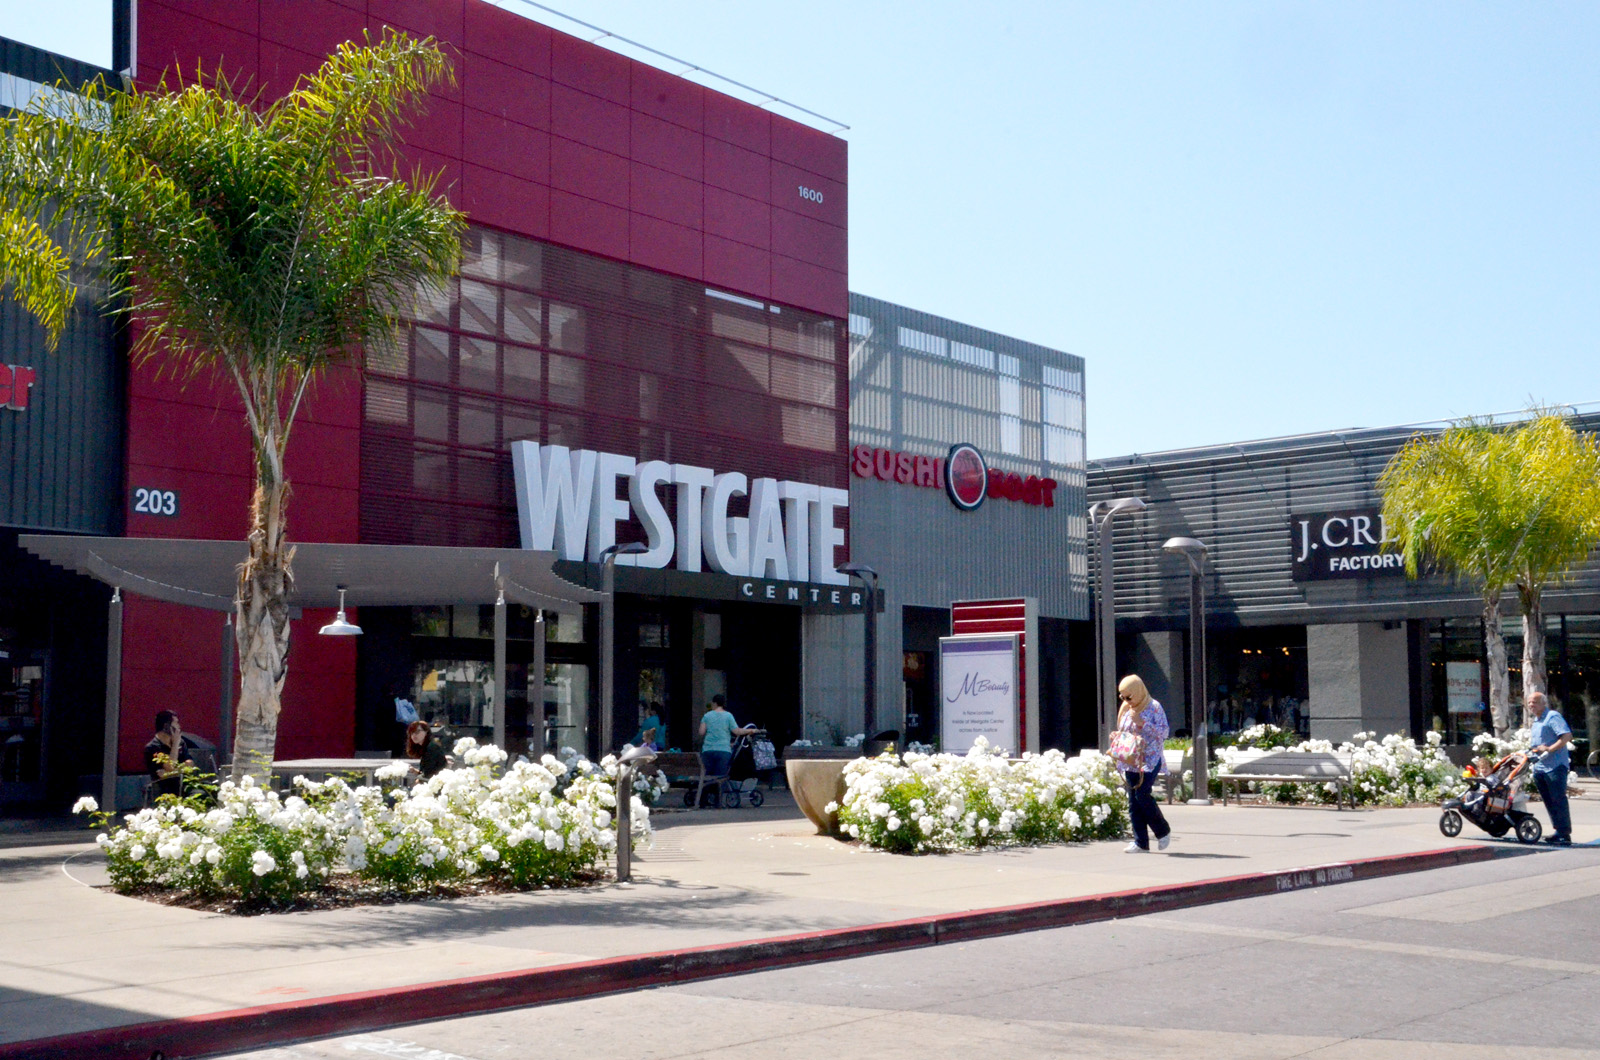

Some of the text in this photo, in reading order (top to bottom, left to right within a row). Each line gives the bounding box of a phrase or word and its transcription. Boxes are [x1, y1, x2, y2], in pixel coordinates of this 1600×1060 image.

[798, 185, 823, 204] 1600
[852, 444, 946, 490] SUSHI
[135, 488, 177, 516] 203
[511, 440, 850, 586] WESTGATE
[1329, 553, 1405, 572] FACTORY
[743, 582, 861, 606] CENTER
[1275, 866, 1353, 890] FIRE LANE NO PARKING
